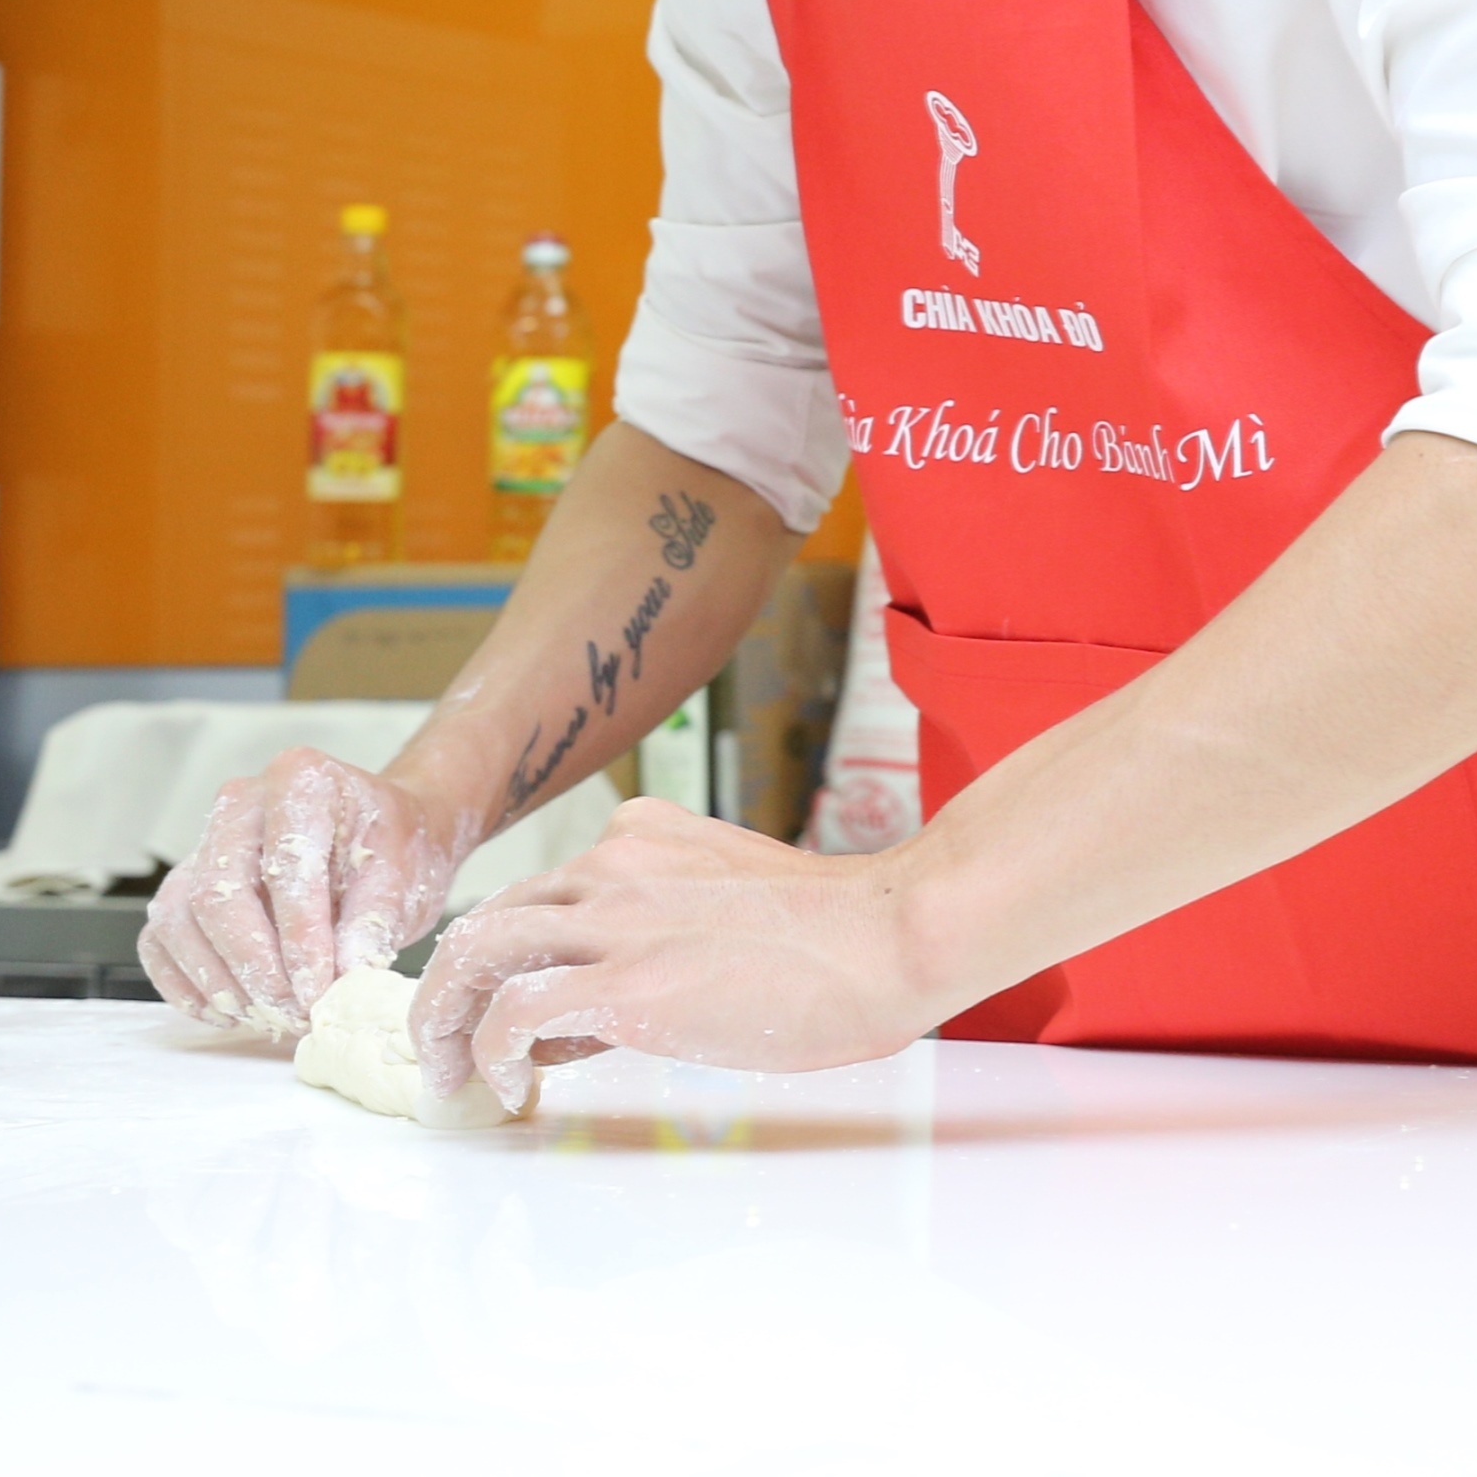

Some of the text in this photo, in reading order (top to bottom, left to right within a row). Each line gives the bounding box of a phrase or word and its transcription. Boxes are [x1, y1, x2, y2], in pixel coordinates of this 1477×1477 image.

[901, 285, 1105, 353] CHÌA KHÓA ĐỎ
[883, 399, 1002, 470] Khoá
[1010, 406, 1084, 474] Cho
[1091, 420, 1176, 484] Bánh
[1176, 412, 1276, 492] Mì
[586, 638, 621, 717] by
